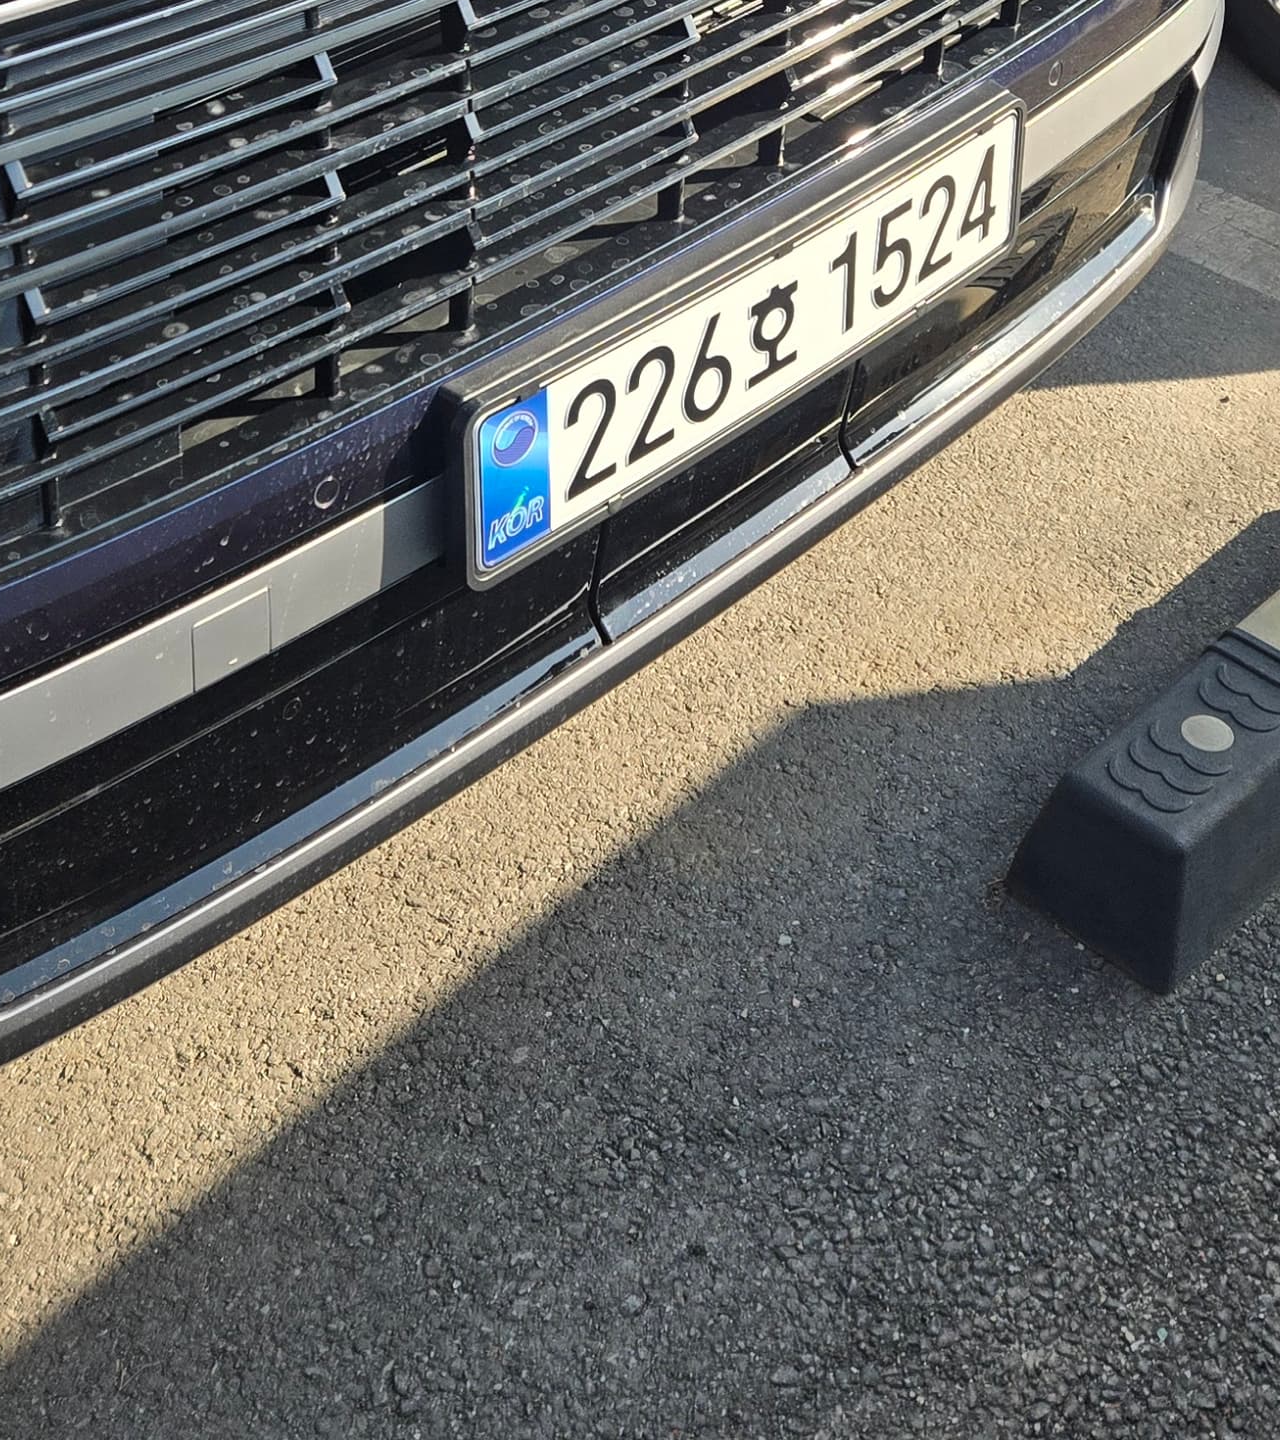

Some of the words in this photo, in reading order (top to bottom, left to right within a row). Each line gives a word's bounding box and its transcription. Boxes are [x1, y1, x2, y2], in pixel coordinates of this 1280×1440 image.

[563, 279, 800, 503] 226호
[828, 143, 998, 335] 1524
[487, 495, 545, 551] KOR
